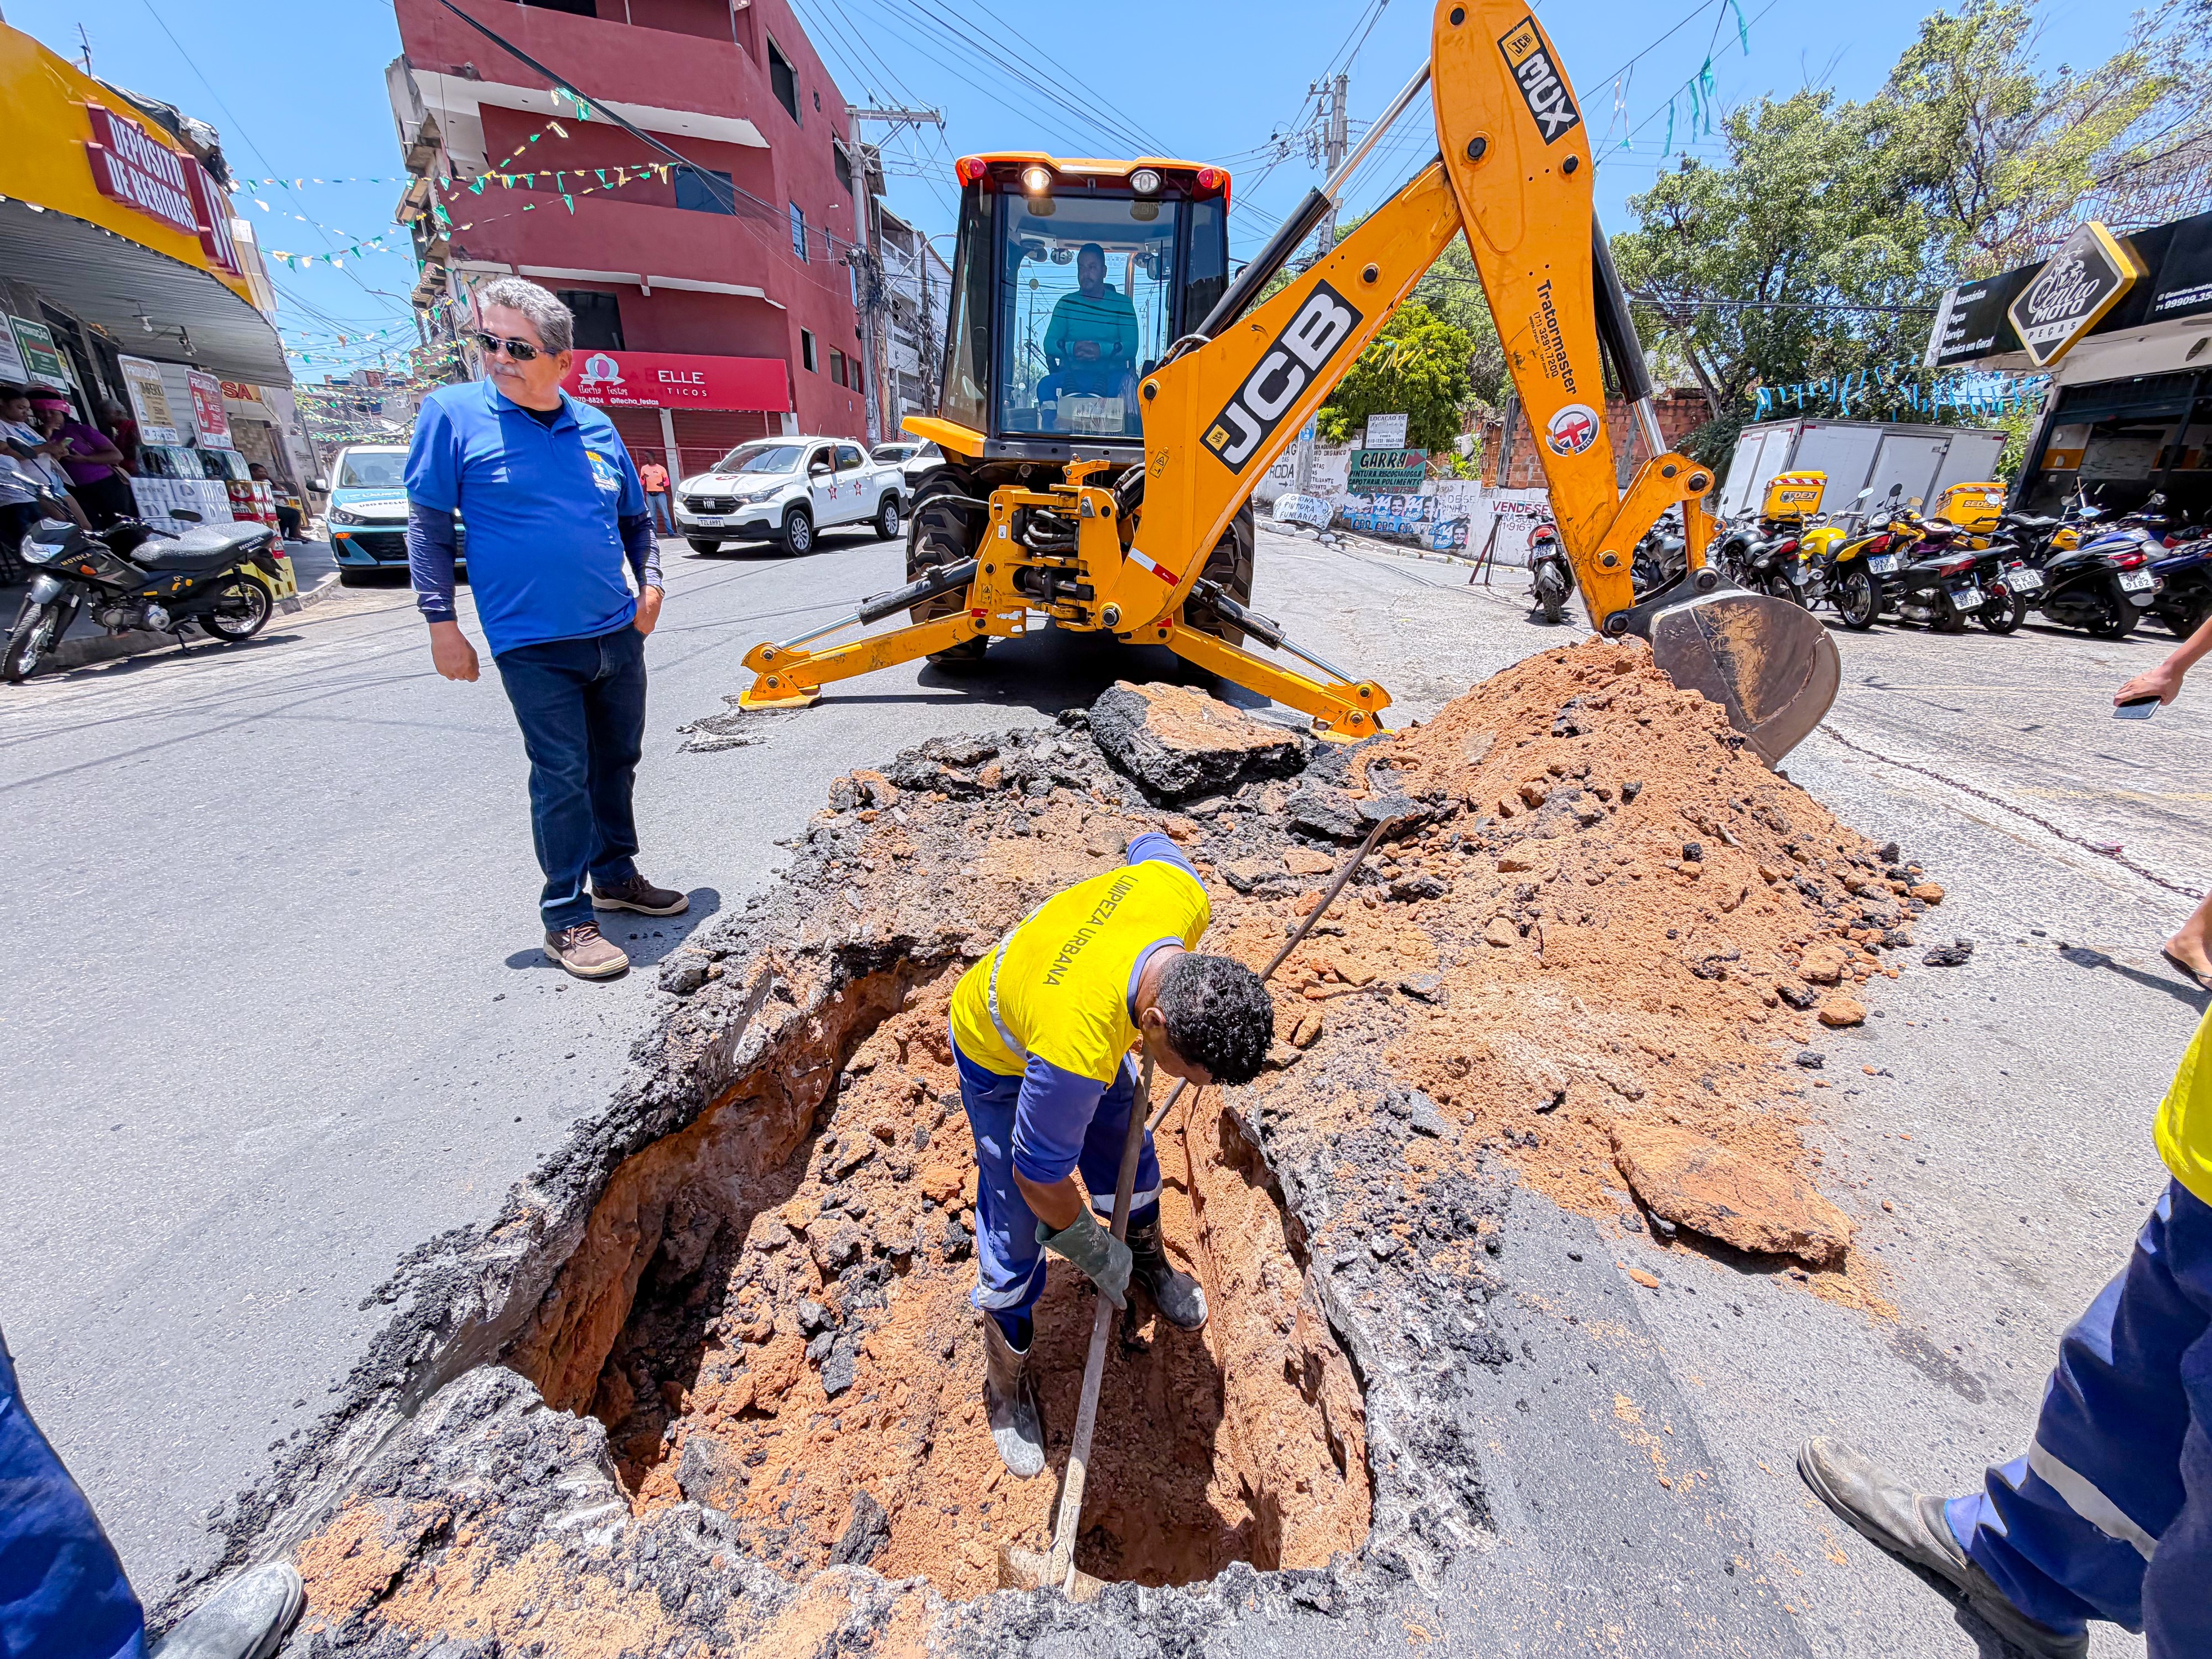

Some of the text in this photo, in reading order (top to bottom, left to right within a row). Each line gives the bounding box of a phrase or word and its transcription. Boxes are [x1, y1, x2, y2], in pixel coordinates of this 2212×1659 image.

[1511, 33, 1531, 54] JCB
[107, 114, 185, 191] DEPÓSITO
[104, 152, 134, 201] DE
[128, 166, 198, 232] BEBIDAS
[1954, 289, 1987, 306] Acessórios
[1949, 312, 1966, 325] Peças
[2031, 298, 2086, 325] MOTO
[1537, 279, 1577, 396] Tratormaster
[2028, 321, 2076, 340] PEÇAS
[1939, 335, 1995, 358] Mecânica em Geral
[1223, 293, 1352, 464] JCB
[610, 397, 659, 405] @flecha_festas
[1209, 431, 1224, 444] JCB
[1360, 452, 1409, 469] GARRA
[1269, 464, 1294, 479] RODA
[238, 537, 264, 550] HONDA
[1086, 875, 1139, 925] LIMPEZA
[1042, 928, 1097, 985] URBANA
